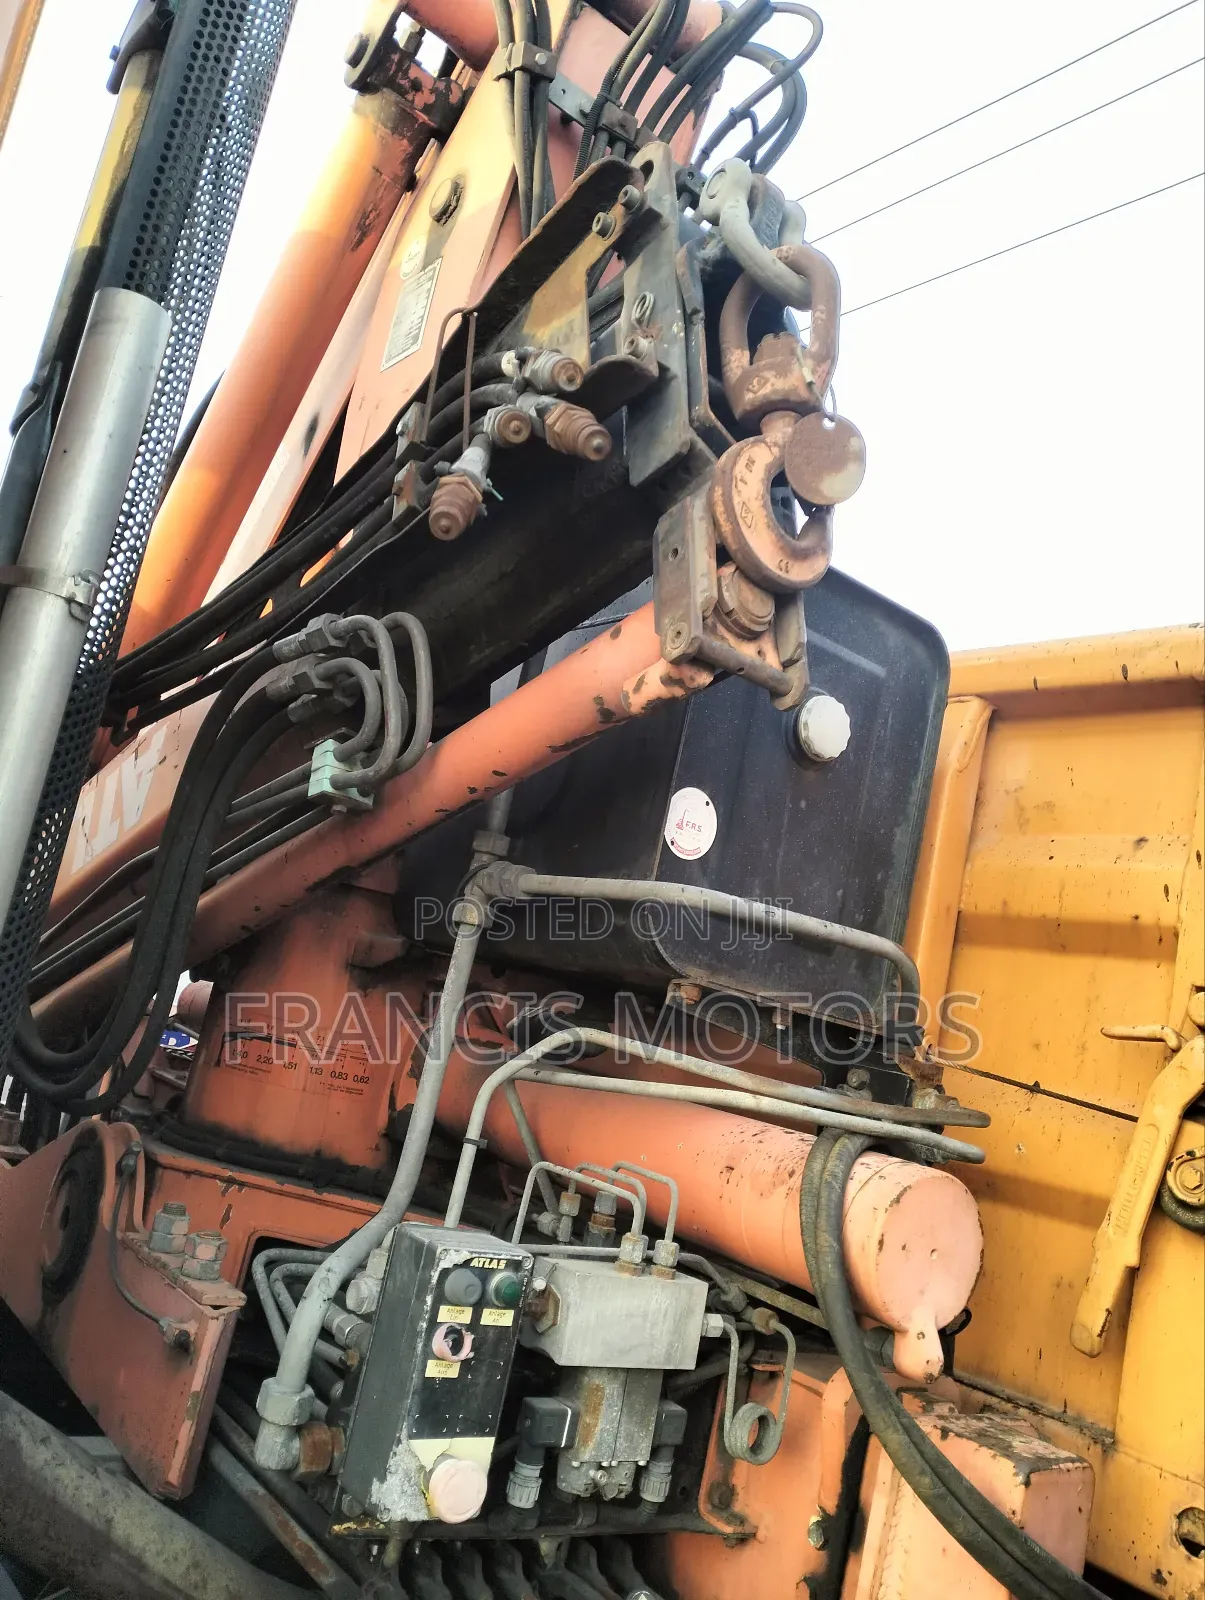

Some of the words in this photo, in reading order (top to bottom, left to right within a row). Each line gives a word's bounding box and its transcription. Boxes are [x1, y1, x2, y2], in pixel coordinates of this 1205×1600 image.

[256, 1055, 273, 1065] 2,20
[330, 1070, 349, 1082] 0,83
[352, 1074, 370, 1085] 0,62
[470, 1257, 507, 1269] ATLAS
